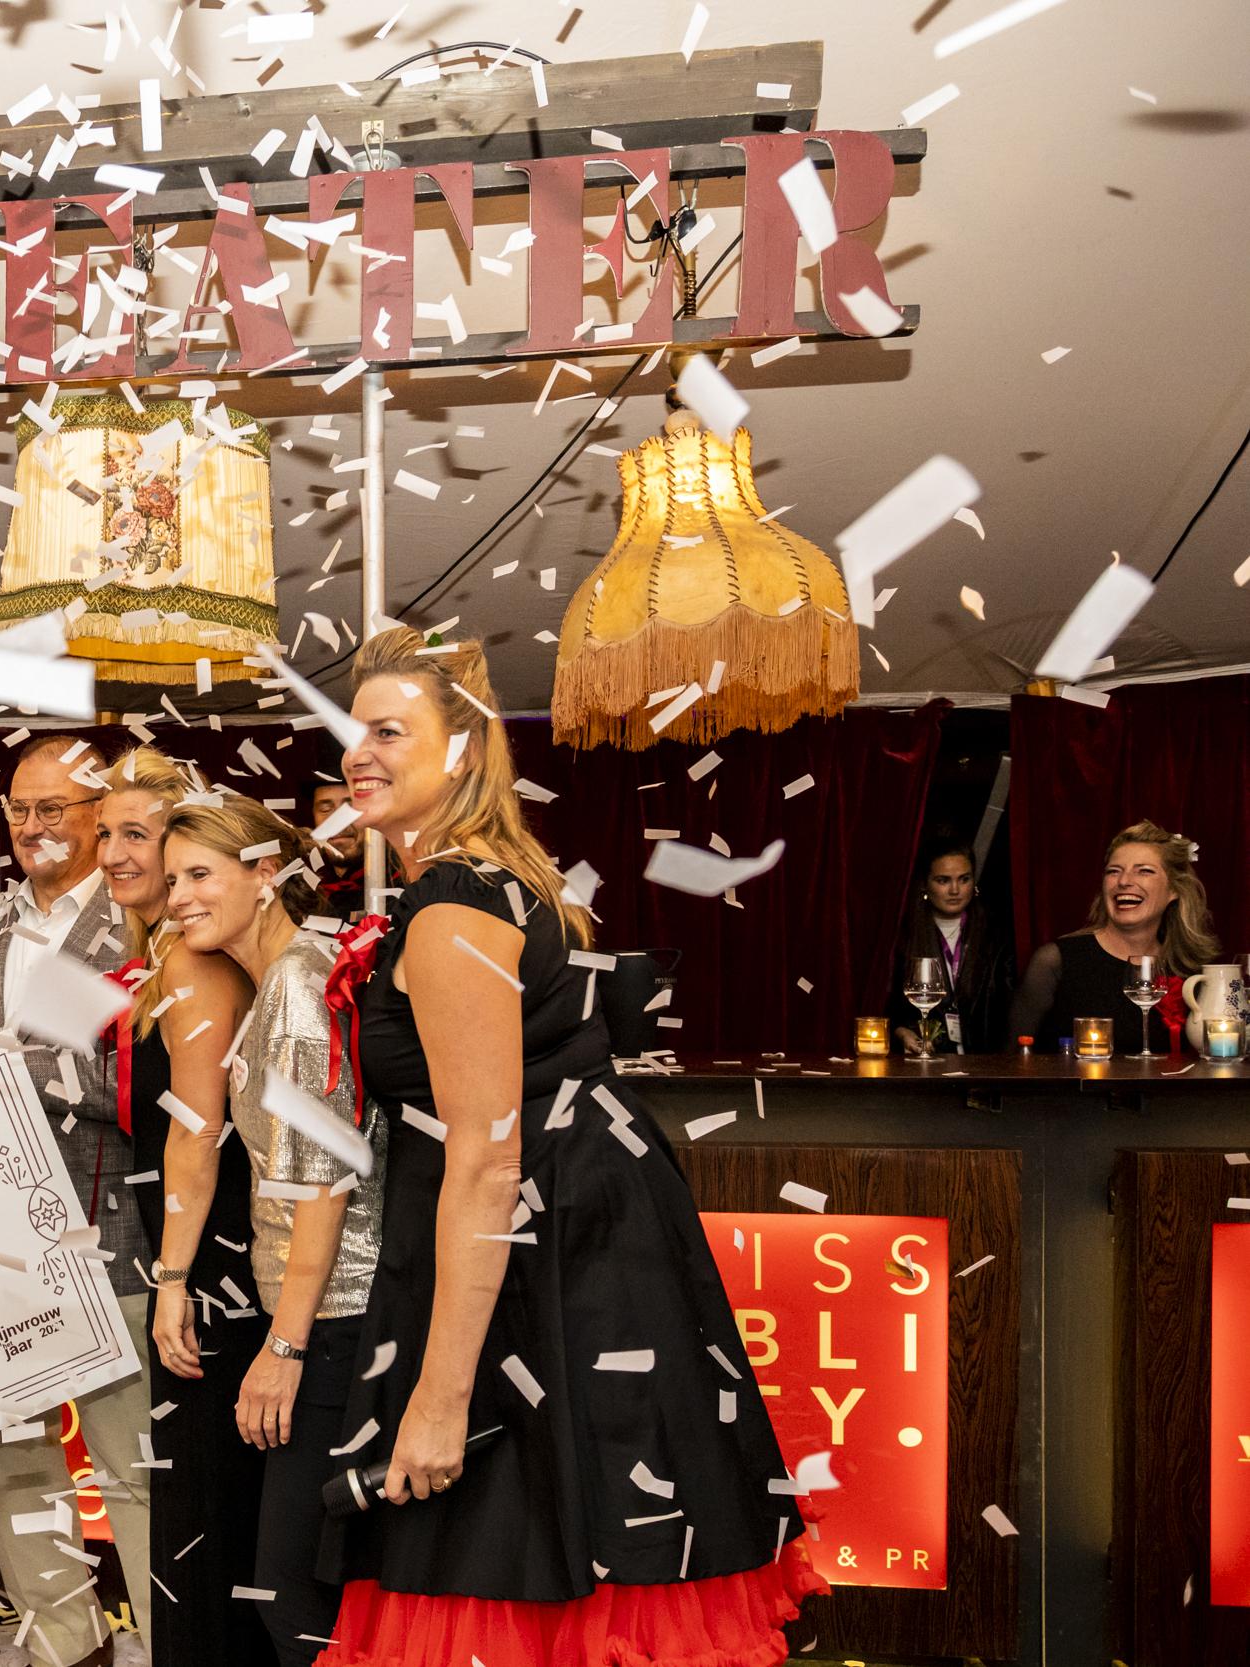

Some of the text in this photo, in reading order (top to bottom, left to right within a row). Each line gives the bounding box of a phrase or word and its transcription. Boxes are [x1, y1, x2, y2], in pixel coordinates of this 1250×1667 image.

[754, 1232, 930, 1295] ISS
[3, 1341, 13, 1349] het
[5, 1338, 32, 1362] jaar
[735, 1309, 918, 1372] BLI
[837, 1545, 930, 1571] & PR
